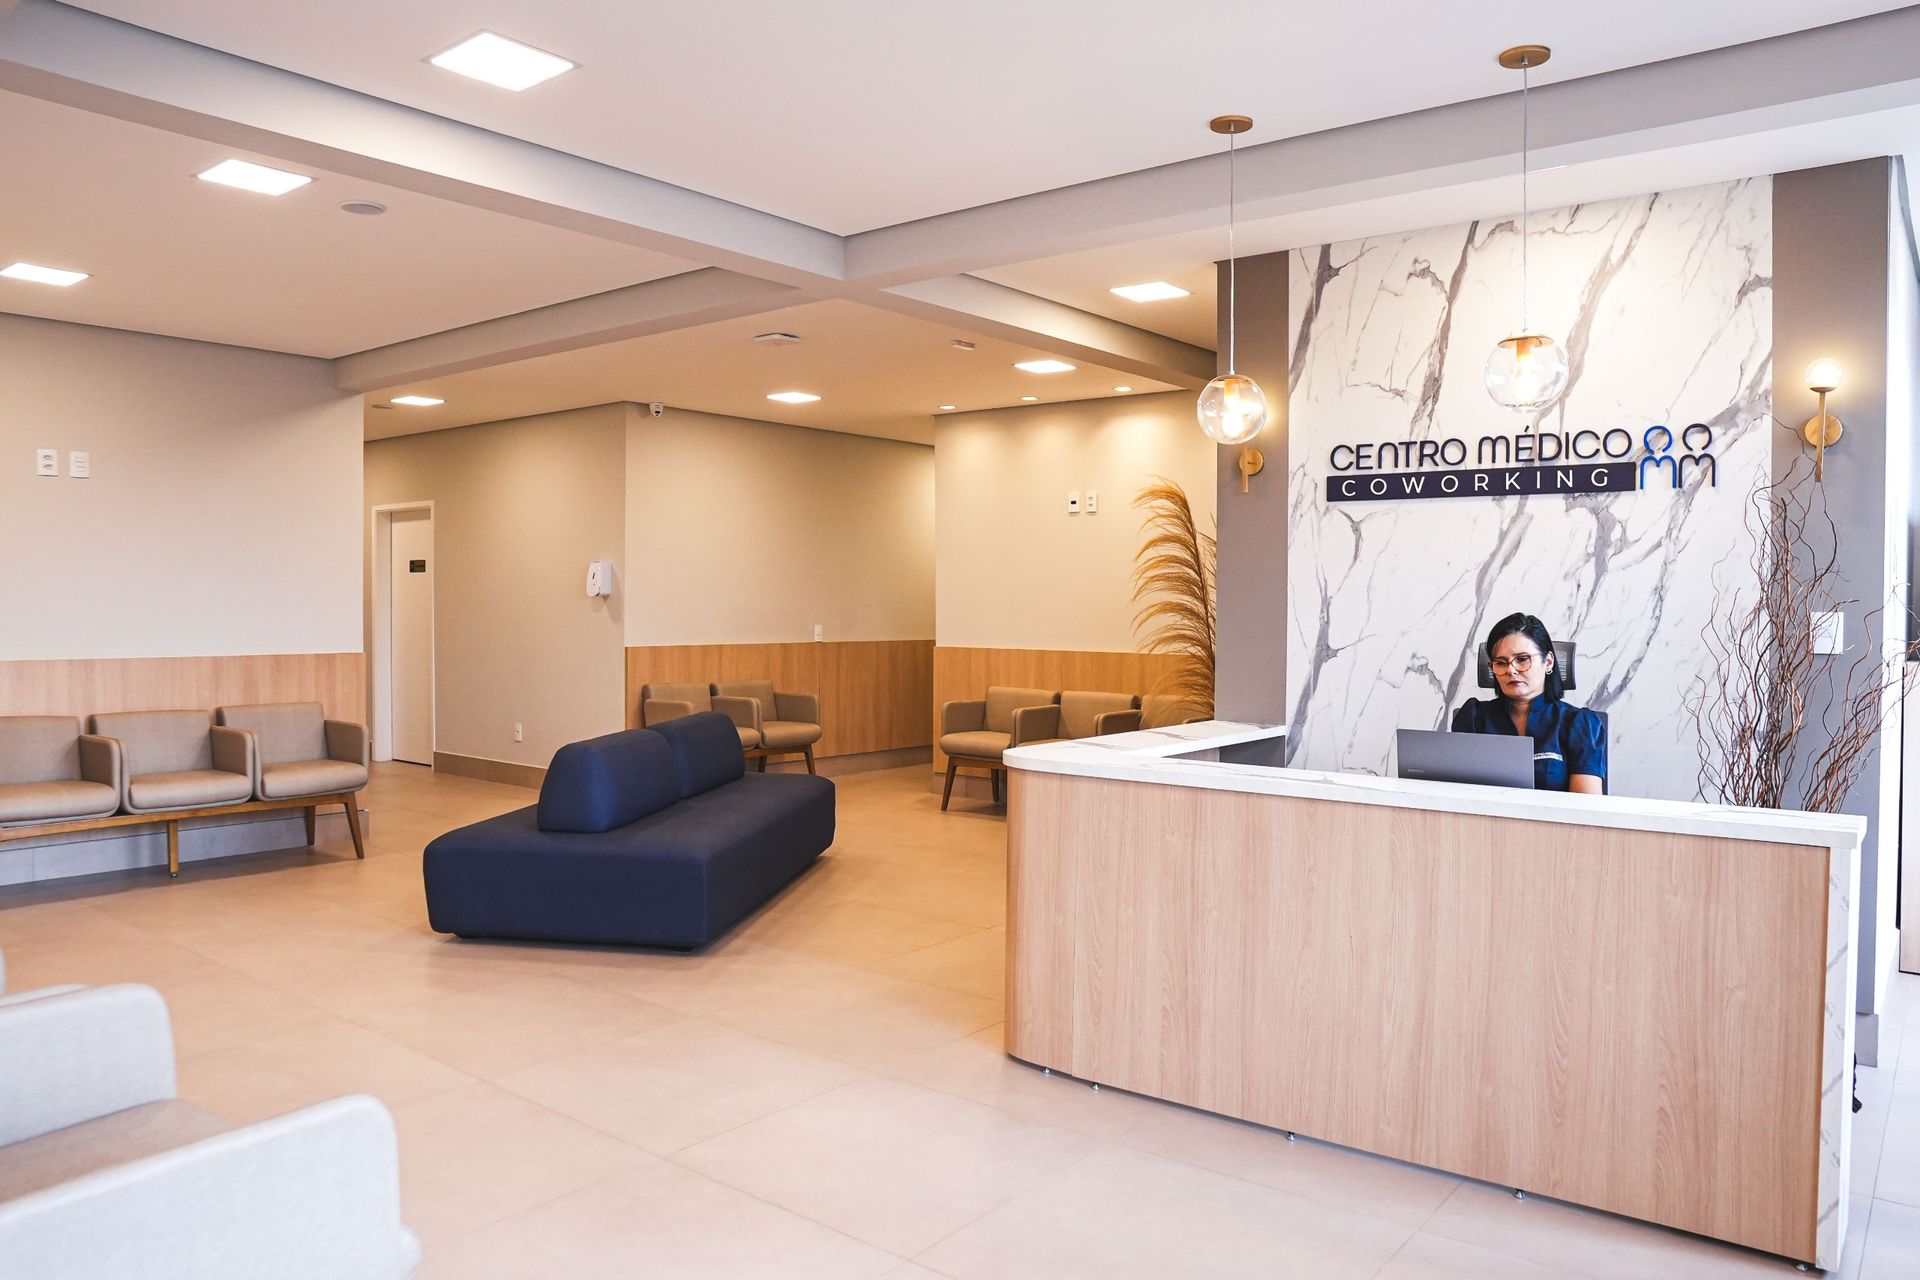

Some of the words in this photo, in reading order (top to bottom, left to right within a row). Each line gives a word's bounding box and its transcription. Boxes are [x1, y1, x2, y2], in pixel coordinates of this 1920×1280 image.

[1330, 438, 1467, 471] CENTRO
[1478, 425, 1632, 464] MÉDICO
[1342, 468, 1608, 497] COWORKING
